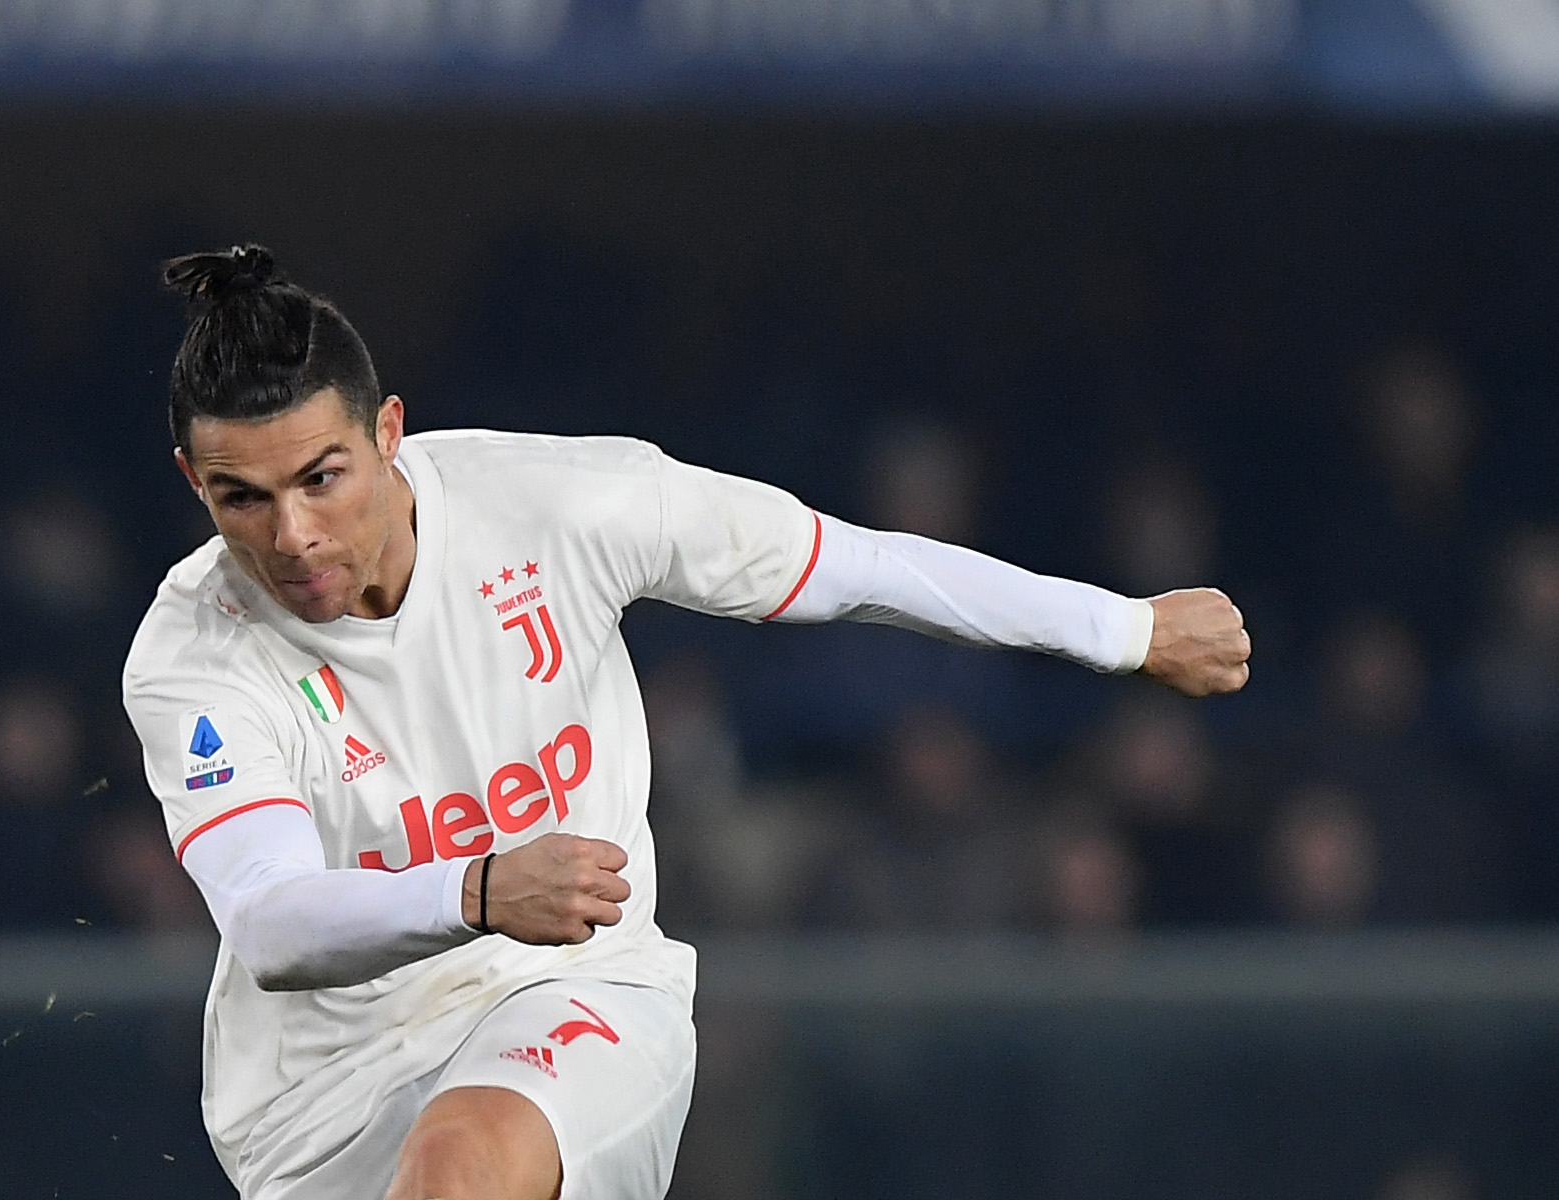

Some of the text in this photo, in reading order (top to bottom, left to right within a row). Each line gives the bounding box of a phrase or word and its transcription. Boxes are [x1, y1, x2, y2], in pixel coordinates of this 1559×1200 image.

[493, 585, 543, 617] JUVENTUS
[189, 760, 218, 774] SERIE
[357, 723, 592, 874] Jeep
